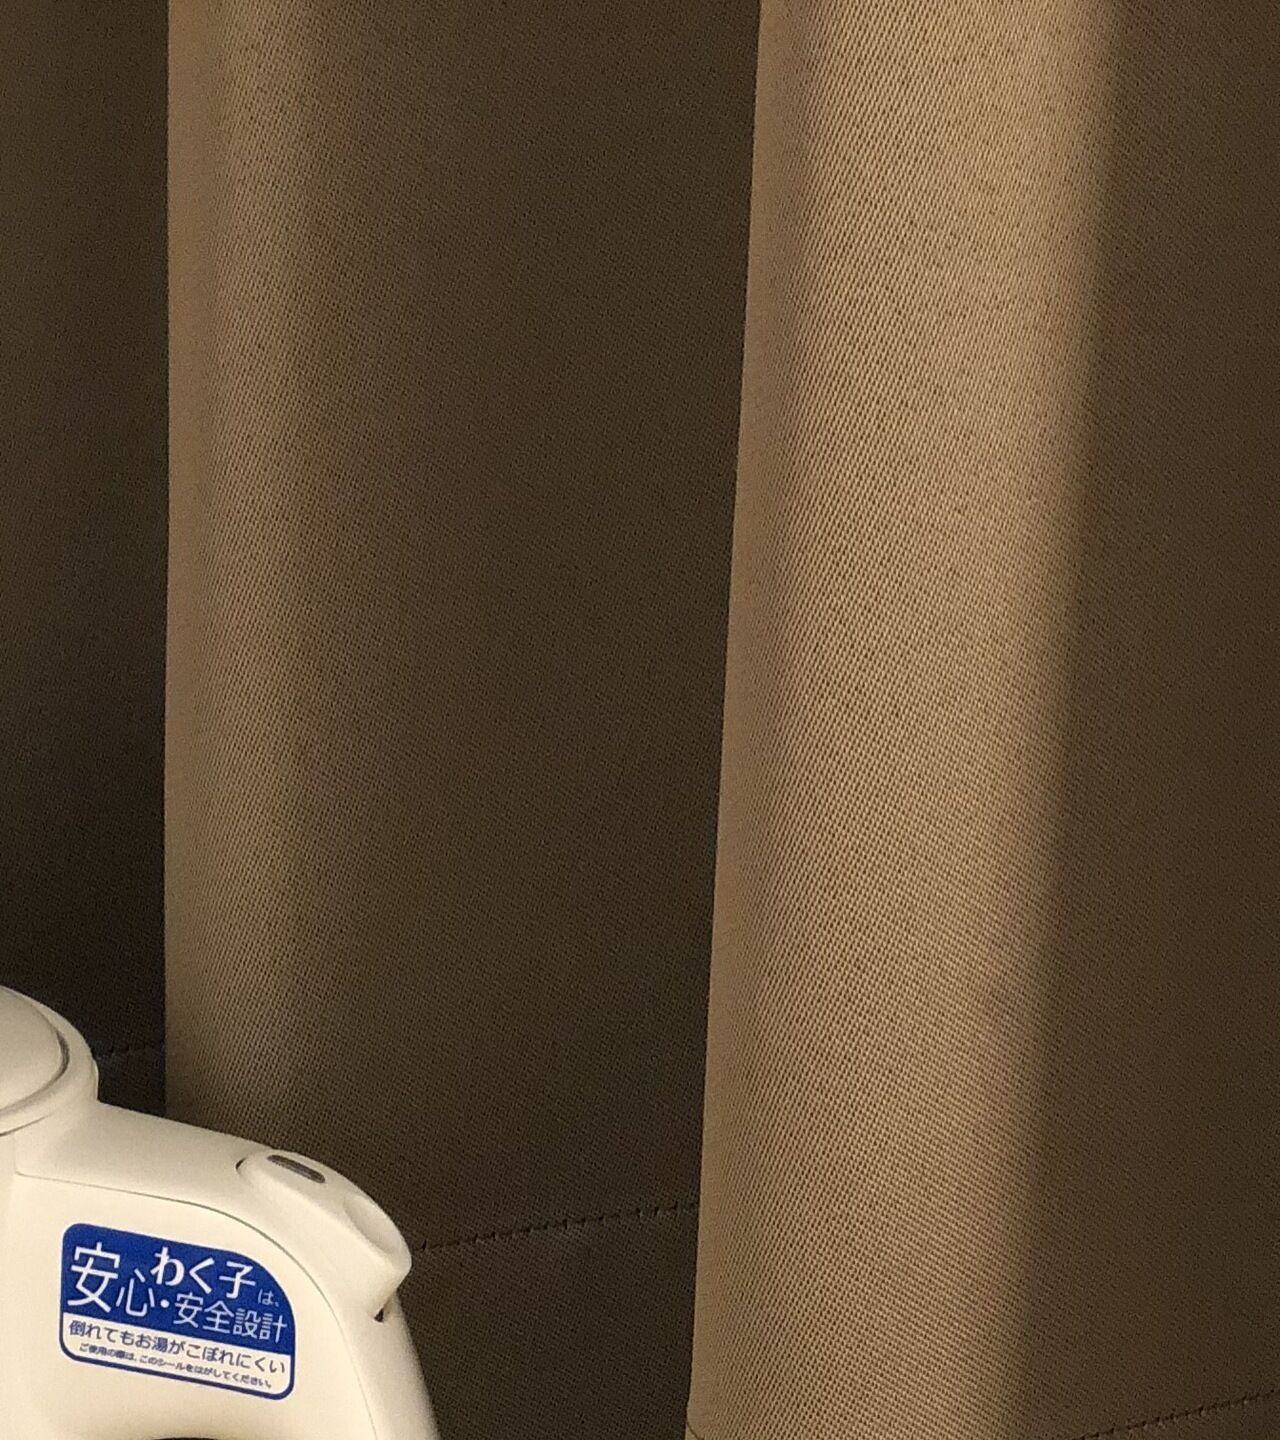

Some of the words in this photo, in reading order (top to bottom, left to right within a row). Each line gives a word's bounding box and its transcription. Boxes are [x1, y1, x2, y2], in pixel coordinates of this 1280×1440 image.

[66, 1241, 288, 1344] 安心・安全設計
[69, 1319, 285, 1374] 倒れてもお湯がこぼれにくい
